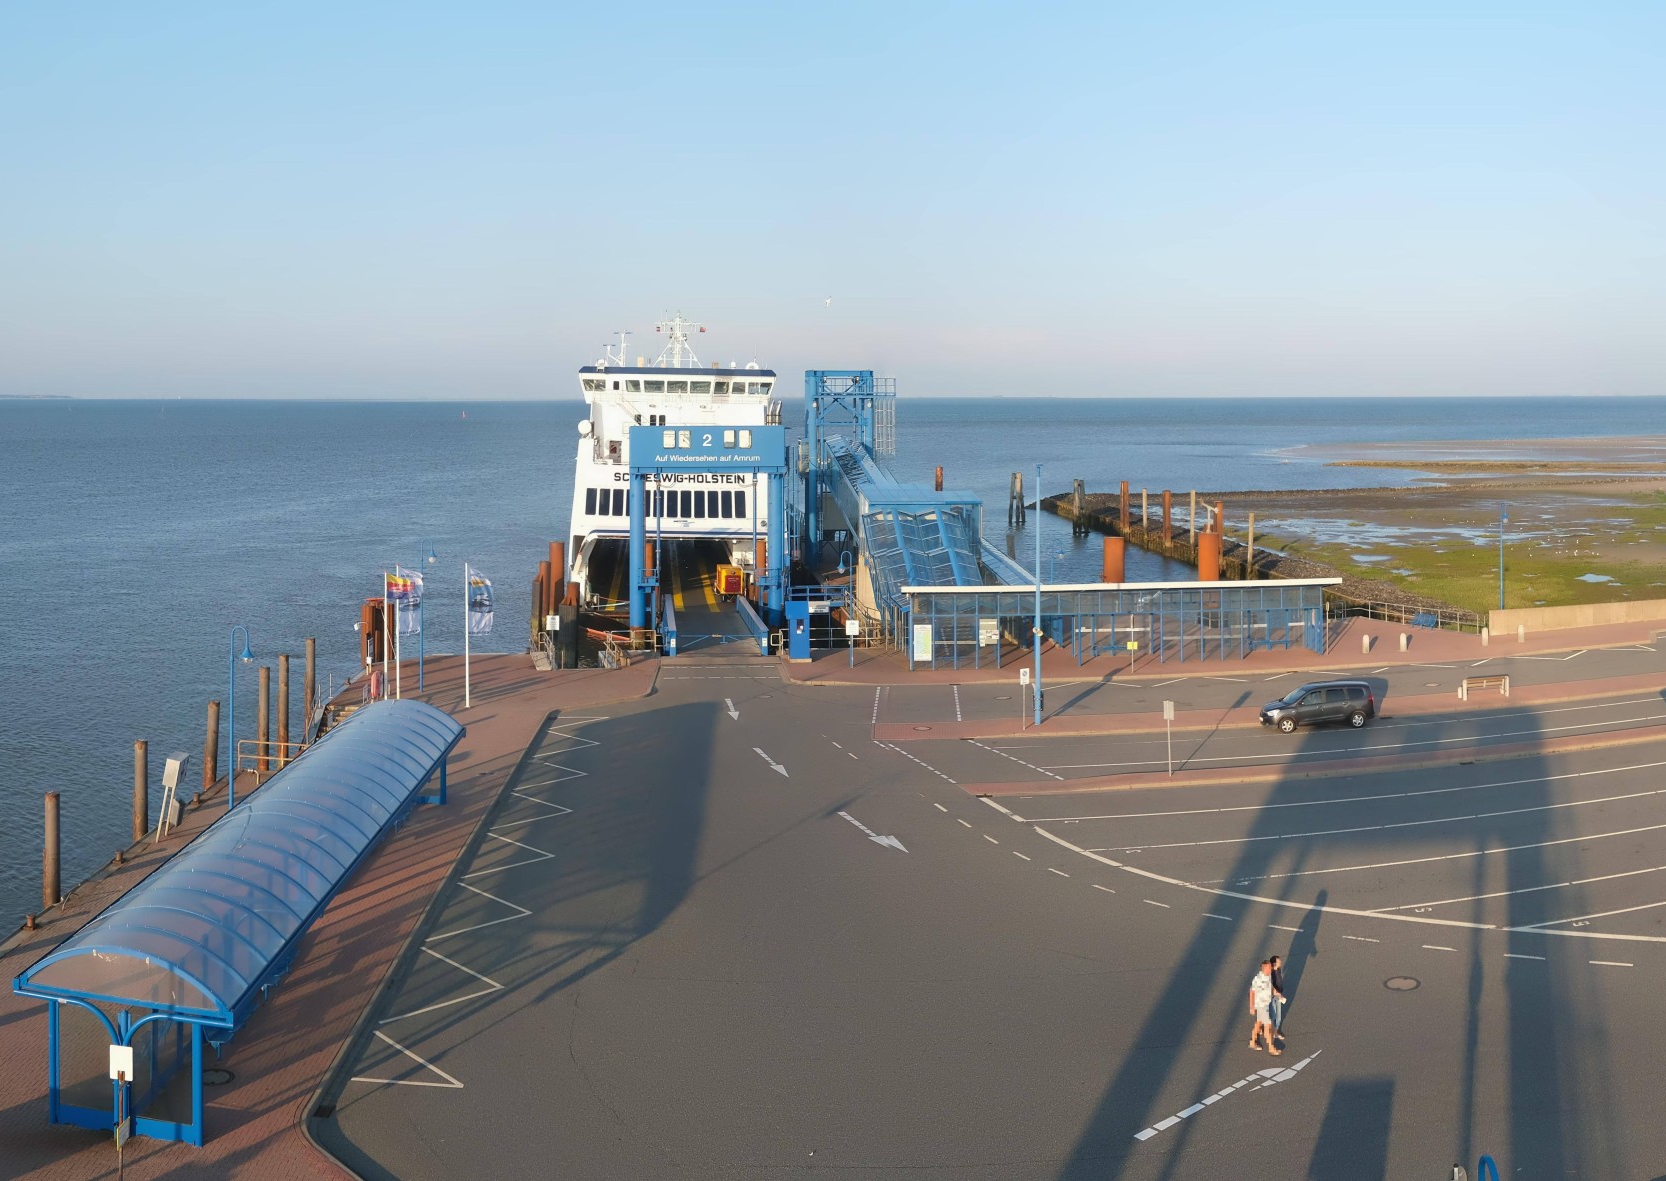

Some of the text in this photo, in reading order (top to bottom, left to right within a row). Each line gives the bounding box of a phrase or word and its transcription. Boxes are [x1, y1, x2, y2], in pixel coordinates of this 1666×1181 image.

[702, 433, 712, 447] 2
[655, 454, 761, 462] Auf Wiedersehen auf Amrum
